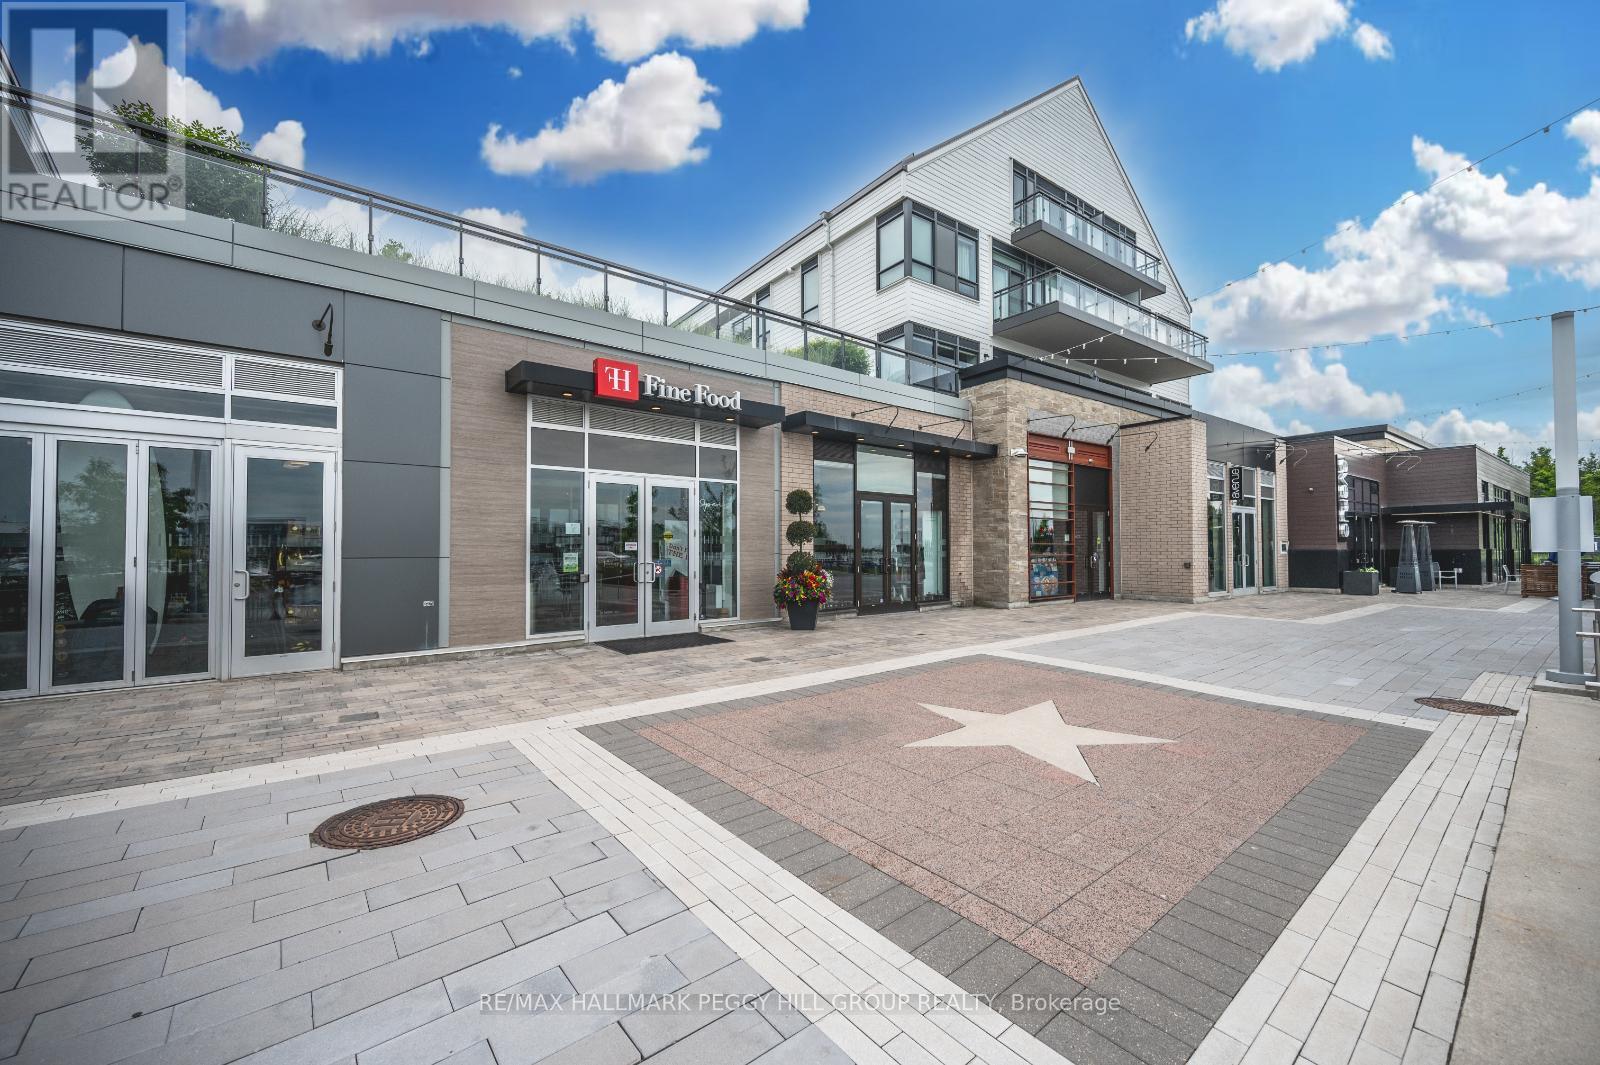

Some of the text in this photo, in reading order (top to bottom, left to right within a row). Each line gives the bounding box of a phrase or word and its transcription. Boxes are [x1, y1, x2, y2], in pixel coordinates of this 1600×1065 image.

[643, 373, 692, 403] Fine
[693, 383, 743, 412] Food
[1231, 468, 1240, 499] avenue
